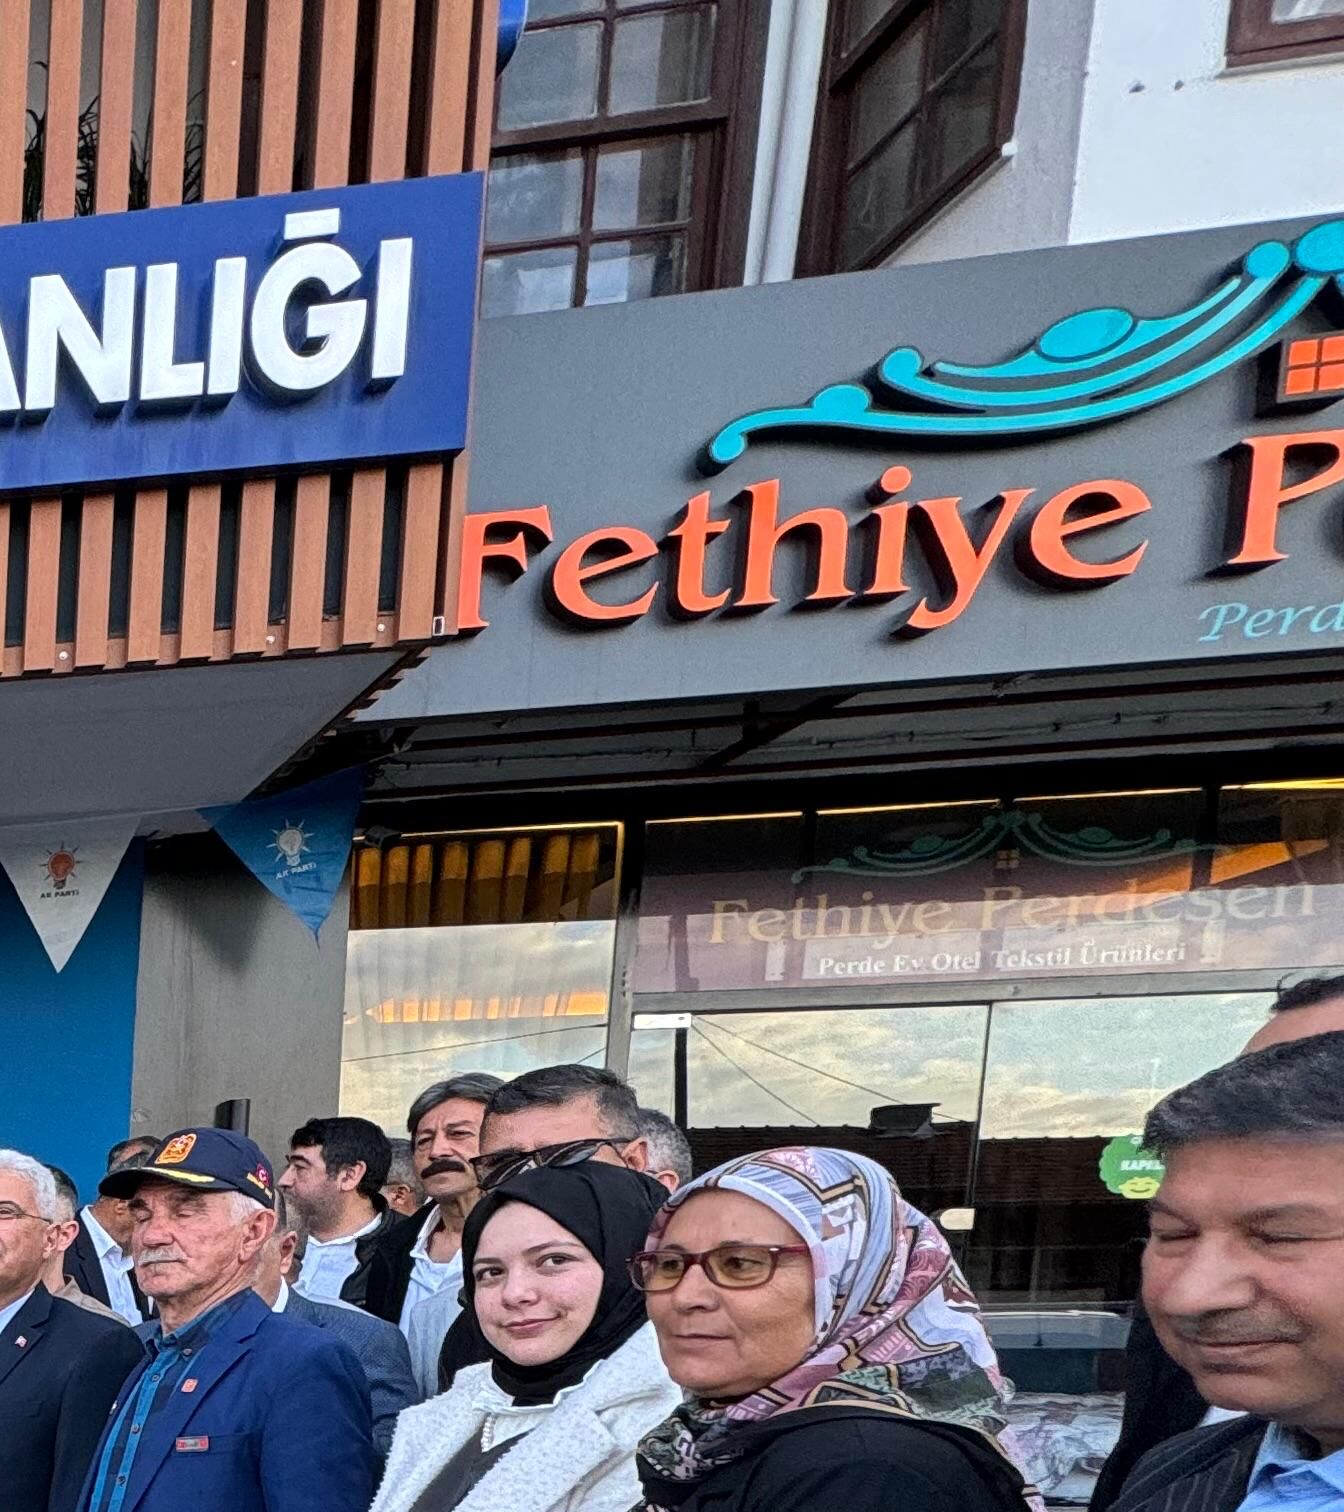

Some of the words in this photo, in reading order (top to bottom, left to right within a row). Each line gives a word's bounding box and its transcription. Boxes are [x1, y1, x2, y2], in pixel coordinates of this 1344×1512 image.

[457, 465, 1151, 631] Fethiye
[708, 890, 955, 950] Fethiye
[819, 955, 885, 976] Perde
[931, 950, 981, 972] Otel
[993, 947, 1071, 969] Tekstil
[1080, 938, 1186, 967] Ürünleri
